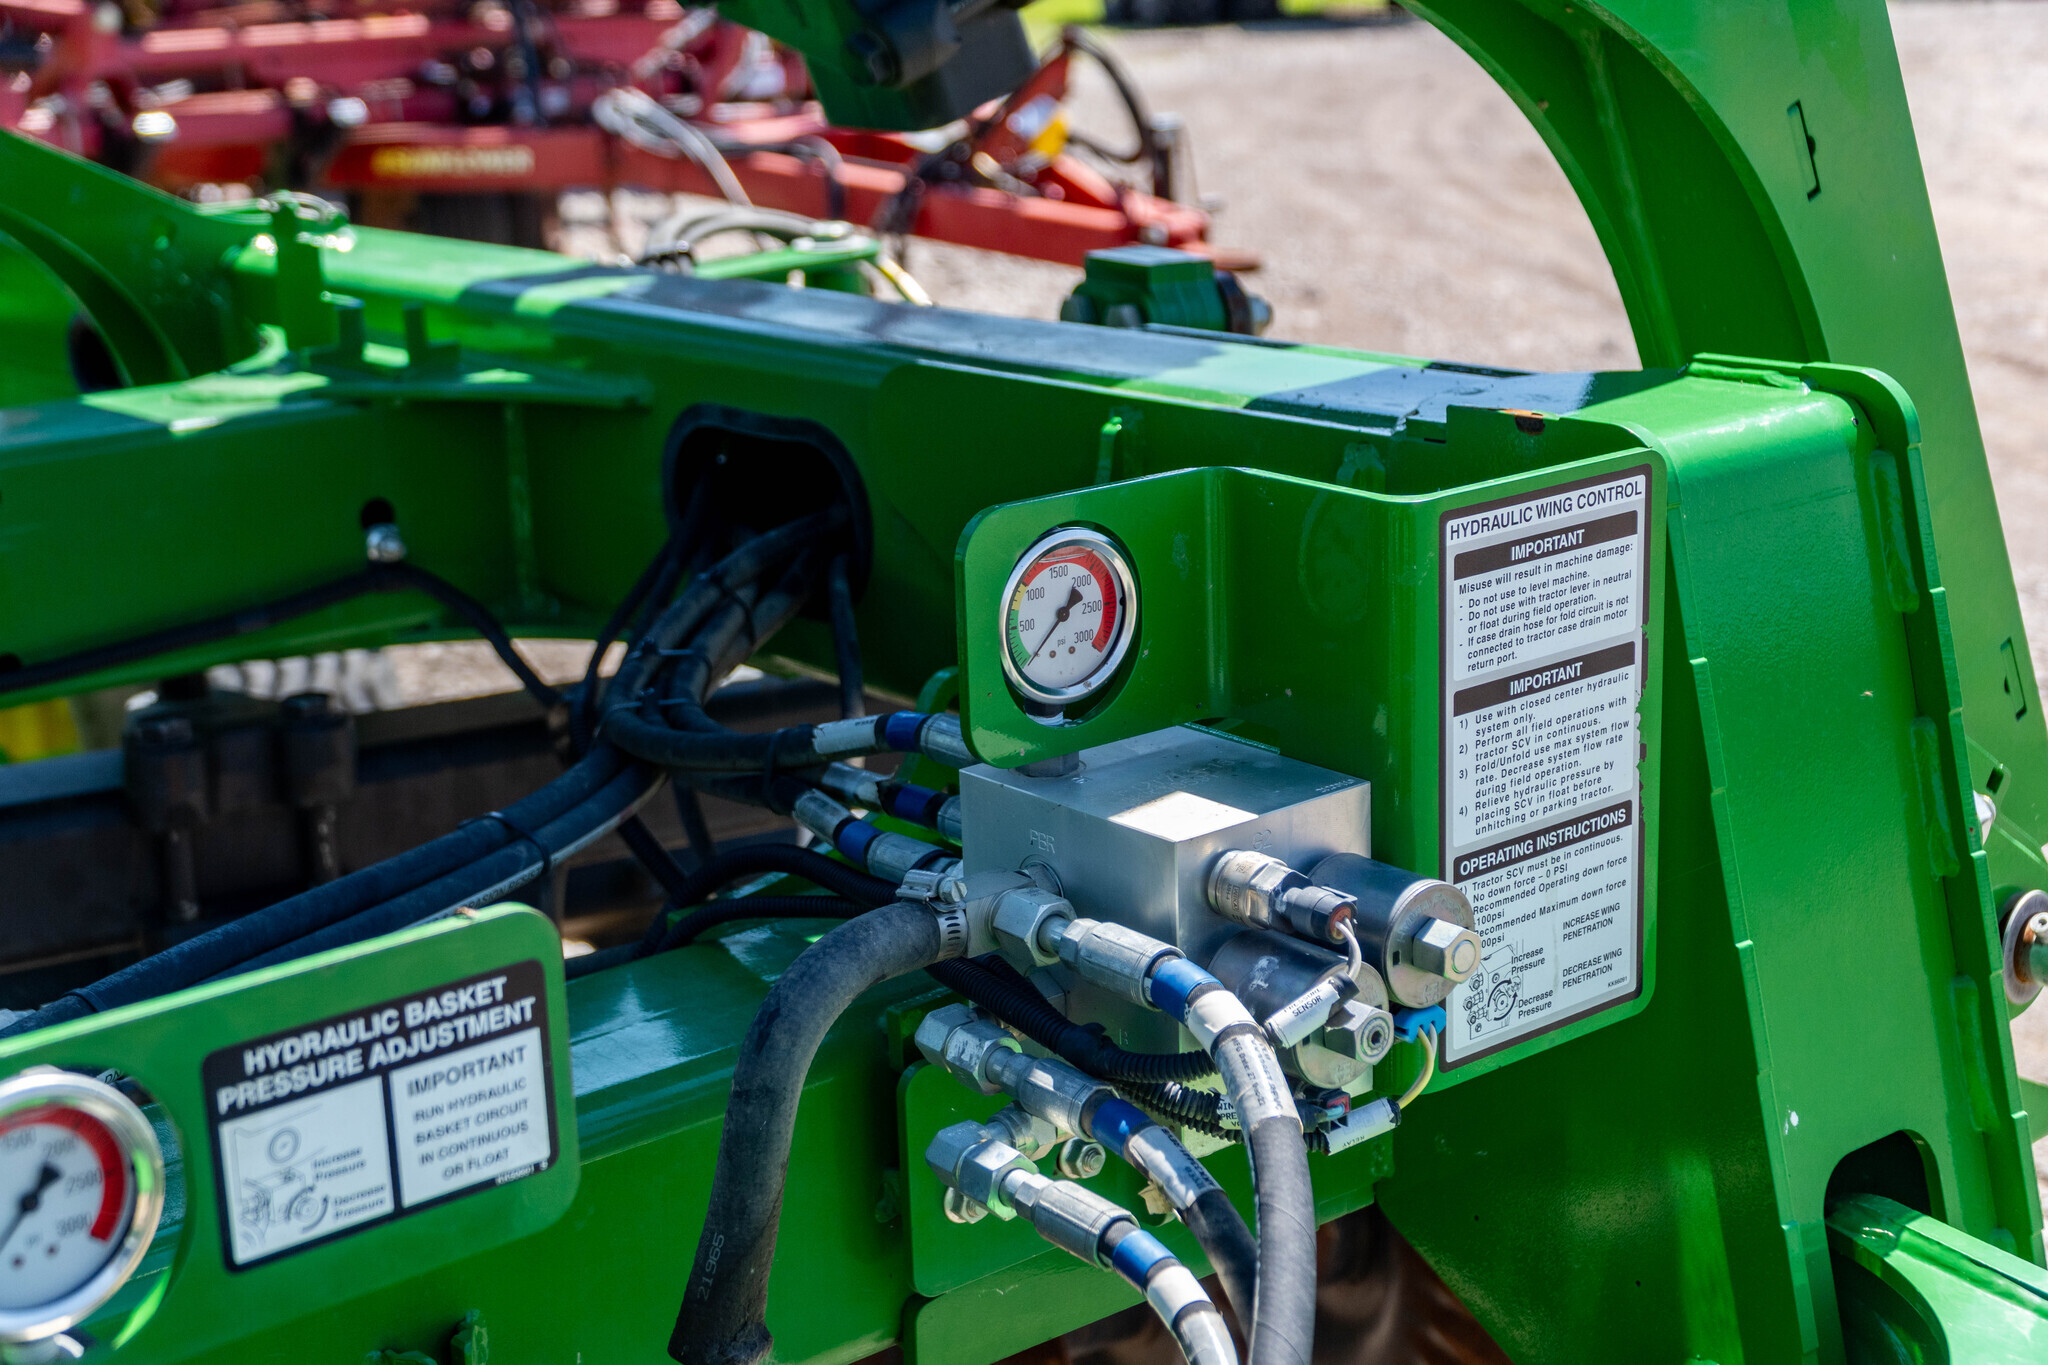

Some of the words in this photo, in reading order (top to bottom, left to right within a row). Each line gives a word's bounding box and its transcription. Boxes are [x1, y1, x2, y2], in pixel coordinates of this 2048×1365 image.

[1450, 507, 1532, 540] HYDRAULIC
[1536, 497, 1572, 519] WING
[1577, 481, 1642, 509] CONTROL
[1511, 529, 1585, 561] IMPORTANT
[1049, 565, 1069, 579] 1500
[1072, 574, 1092, 589] 2000
[1459, 579, 1492, 595] Misuse
[1496, 572, 1511, 585] will
[1515, 565, 1541, 581] result
[1544, 564, 1552, 575] in
[1556, 553, 1593, 570] machine
[1596, 543, 1633, 561] damage:
[1026, 587, 1045, 601] 1000
[1082, 600, 1102, 615] 2500
[1469, 598, 1480, 609] Do
[1483, 593, 1497, 606] not
[1501, 590, 1514, 601] use
[1518, 586, 1527, 596] to
[1530, 578, 1550, 592] level
[1553, 570, 1589, 587] machine.
[1469, 611, 1480, 621] Do
[1484, 606, 1498, 618] not
[1501, 603, 1515, 613] use
[1519, 594, 1536, 609] with
[1539, 587, 1567, 604] tractor
[1570, 582, 1590, 596] lever
[1593, 577, 1600, 588] in
[1603, 570, 1632, 586] neutral
[1020, 618, 1034, 632] 500
[1468, 624, 1477, 634] or
[1480, 618, 1500, 631] float
[1502, 610, 1530, 628] during
[1533, 604, 1551, 620] field
[1554, 593, 1596, 615] operation.
[1468, 637, 1474, 647] If
[1476, 632, 1496, 644] case
[1499, 625, 1521, 639] drain
[1524, 620, 1543, 634] hose
[1546, 615, 1557, 627] for
[1560, 608, 1576, 623] fold
[1578, 602, 1603, 618] circuit
[1606, 599, 1613, 609] is
[1616, 595, 1629, 607] not
[1057, 636, 1066, 647] psi
[1074, 629, 1094, 644] 3000
[1468, 639, 1513, 659] connected
[1516, 636, 1524, 646] to
[1527, 627, 1555, 643] tractor
[1558, 623, 1577, 635] case
[1580, 616, 1600, 630] drain
[1604, 608, 1627, 623] motor
[1468, 659, 1494, 673] return
[1497, 653, 1517, 665] port.
[1510, 662, 1583, 696] IMPORTANT
[1460, 719, 1468, 730] 1)
[1476, 713, 1492, 724] Use
[1497, 705, 1517, 718] with
[1520, 694, 1551, 711] closed
[1555, 687, 1583, 701] center
[1587, 672, 1629, 692] hydraulic
[1459, 745, 1468, 755] 2)
[1476, 729, 1513, 749] Perform
[1516, 723, 1528, 735] all
[1531, 718, 1551, 733] field
[1556, 703, 1604, 726] operations
[1609, 696, 1627, 710] with
[1476, 717, 1510, 737] system
[1513, 713, 1536, 728] only.
[1476, 744, 1508, 762] tractor
[1512, 738, 1531, 751] SCV
[1534, 733, 1543, 743] in
[1547, 719, 1601, 739] continuous.
[1459, 769, 1468, 779] 3)
[1476, 751, 1531, 774] Fold/Unfold
[1534, 745, 1550, 756] use
[1554, 739, 1572, 750] max
[1576, 727, 1607, 746] system
[1611, 720, 1629, 733] flow
[1476, 775, 1497, 787] rate.
[1501, 759, 1544, 778] Decrease
[1548, 747, 1580, 764] system
[1583, 740, 1602, 753] flow
[1606, 734, 1623, 746] rate
[1459, 805, 1468, 816] 4)
[1476, 793, 1510, 811] Relieve
[1514, 778, 1557, 799] hydraulic
[1561, 764, 1601, 785] pressure
[1604, 760, 1614, 772] by
[1476, 783, 1507, 799] during
[1510, 775, 1531, 788] field
[1534, 761, 1582, 783] operation.
[1476, 806, 1510, 825] placing
[1514, 799, 1533, 811] SCV
[1537, 795, 1545, 804] in
[1549, 787, 1570, 800] float
[1573, 776, 1602, 791] before
[1476, 812, 1526, 835] unhitching
[1530, 809, 1539, 818] or
[1543, 797, 1577, 816] parking
[1581, 785, 1613, 801] tractor.
[1460, 841, 1533, 876] OPERATING
[1537, 808, 1626, 851] INSTRUCTIONS
[1473, 875, 1503, 891] Tractor
[1507, 866, 1524, 879] SCV
[1528, 859, 1548, 872] must
[1551, 855, 1561, 864] be
[1564, 852, 1571, 861] in
[1575, 836, 1623, 856] continuous.
[1473, 894, 1484, 903] No
[1488, 886, 1511, 898] down
[1514, 876, 1536, 889] force
[1546, 869, 1551, 879] 0
[1554, 864, 1568, 874] PSI
[1473, 888, 1536, 915] Recommended
[1539, 872, 1580, 893] Operating
[1582, 865, 1604, 878] down
[1607, 855, 1627, 868] force
[1539, 897, 1579, 916] Maximum
[1581, 888, 1603, 901] down
[1606, 879, 1626, 893] force
[1563, 910, 1600, 931] INCREASE
[1601, 903, 1620, 918] WING
[1563, 918, 1613, 942] PENETRATION
[1482, 934, 1505, 949] 00psi
[1511, 946, 1544, 964] Increase
[1512, 957, 1545, 975] Pressure
[1563, 957, 1602, 978] DECREASE
[1604, 948, 1623, 962] WING
[1563, 964, 1612, 989] PENETRATION
[1292, 995, 1323, 1017] SENSOR
[1518, 989, 1553, 1008] Decrease
[1518, 1000, 1552, 1019] Pressure
[244, 1009, 400, 1076] HYDRAULIC
[404, 976, 507, 1028] BASKET
[217, 1049, 364, 1115] PRESSURE
[369, 997, 536, 1069] ADJUSTMENT
[407, 1045, 527, 1097] IMPORTANT
[415, 1104, 444, 1122] RUN
[448, 1078, 527, 1114] HYDRAULIC
[415, 1118, 471, 1144] BASKET
[476, 1098, 529, 1124] CIRCUIT
[313, 1146, 362, 1170] Increase
[420, 1150, 435, 1166] IN
[438, 1121, 529, 1161] CONTINUOUS
[315, 1159, 366, 1182] Pressure
[442, 1161, 464, 1180] OR
[468, 1148, 510, 1173] FLOAT
